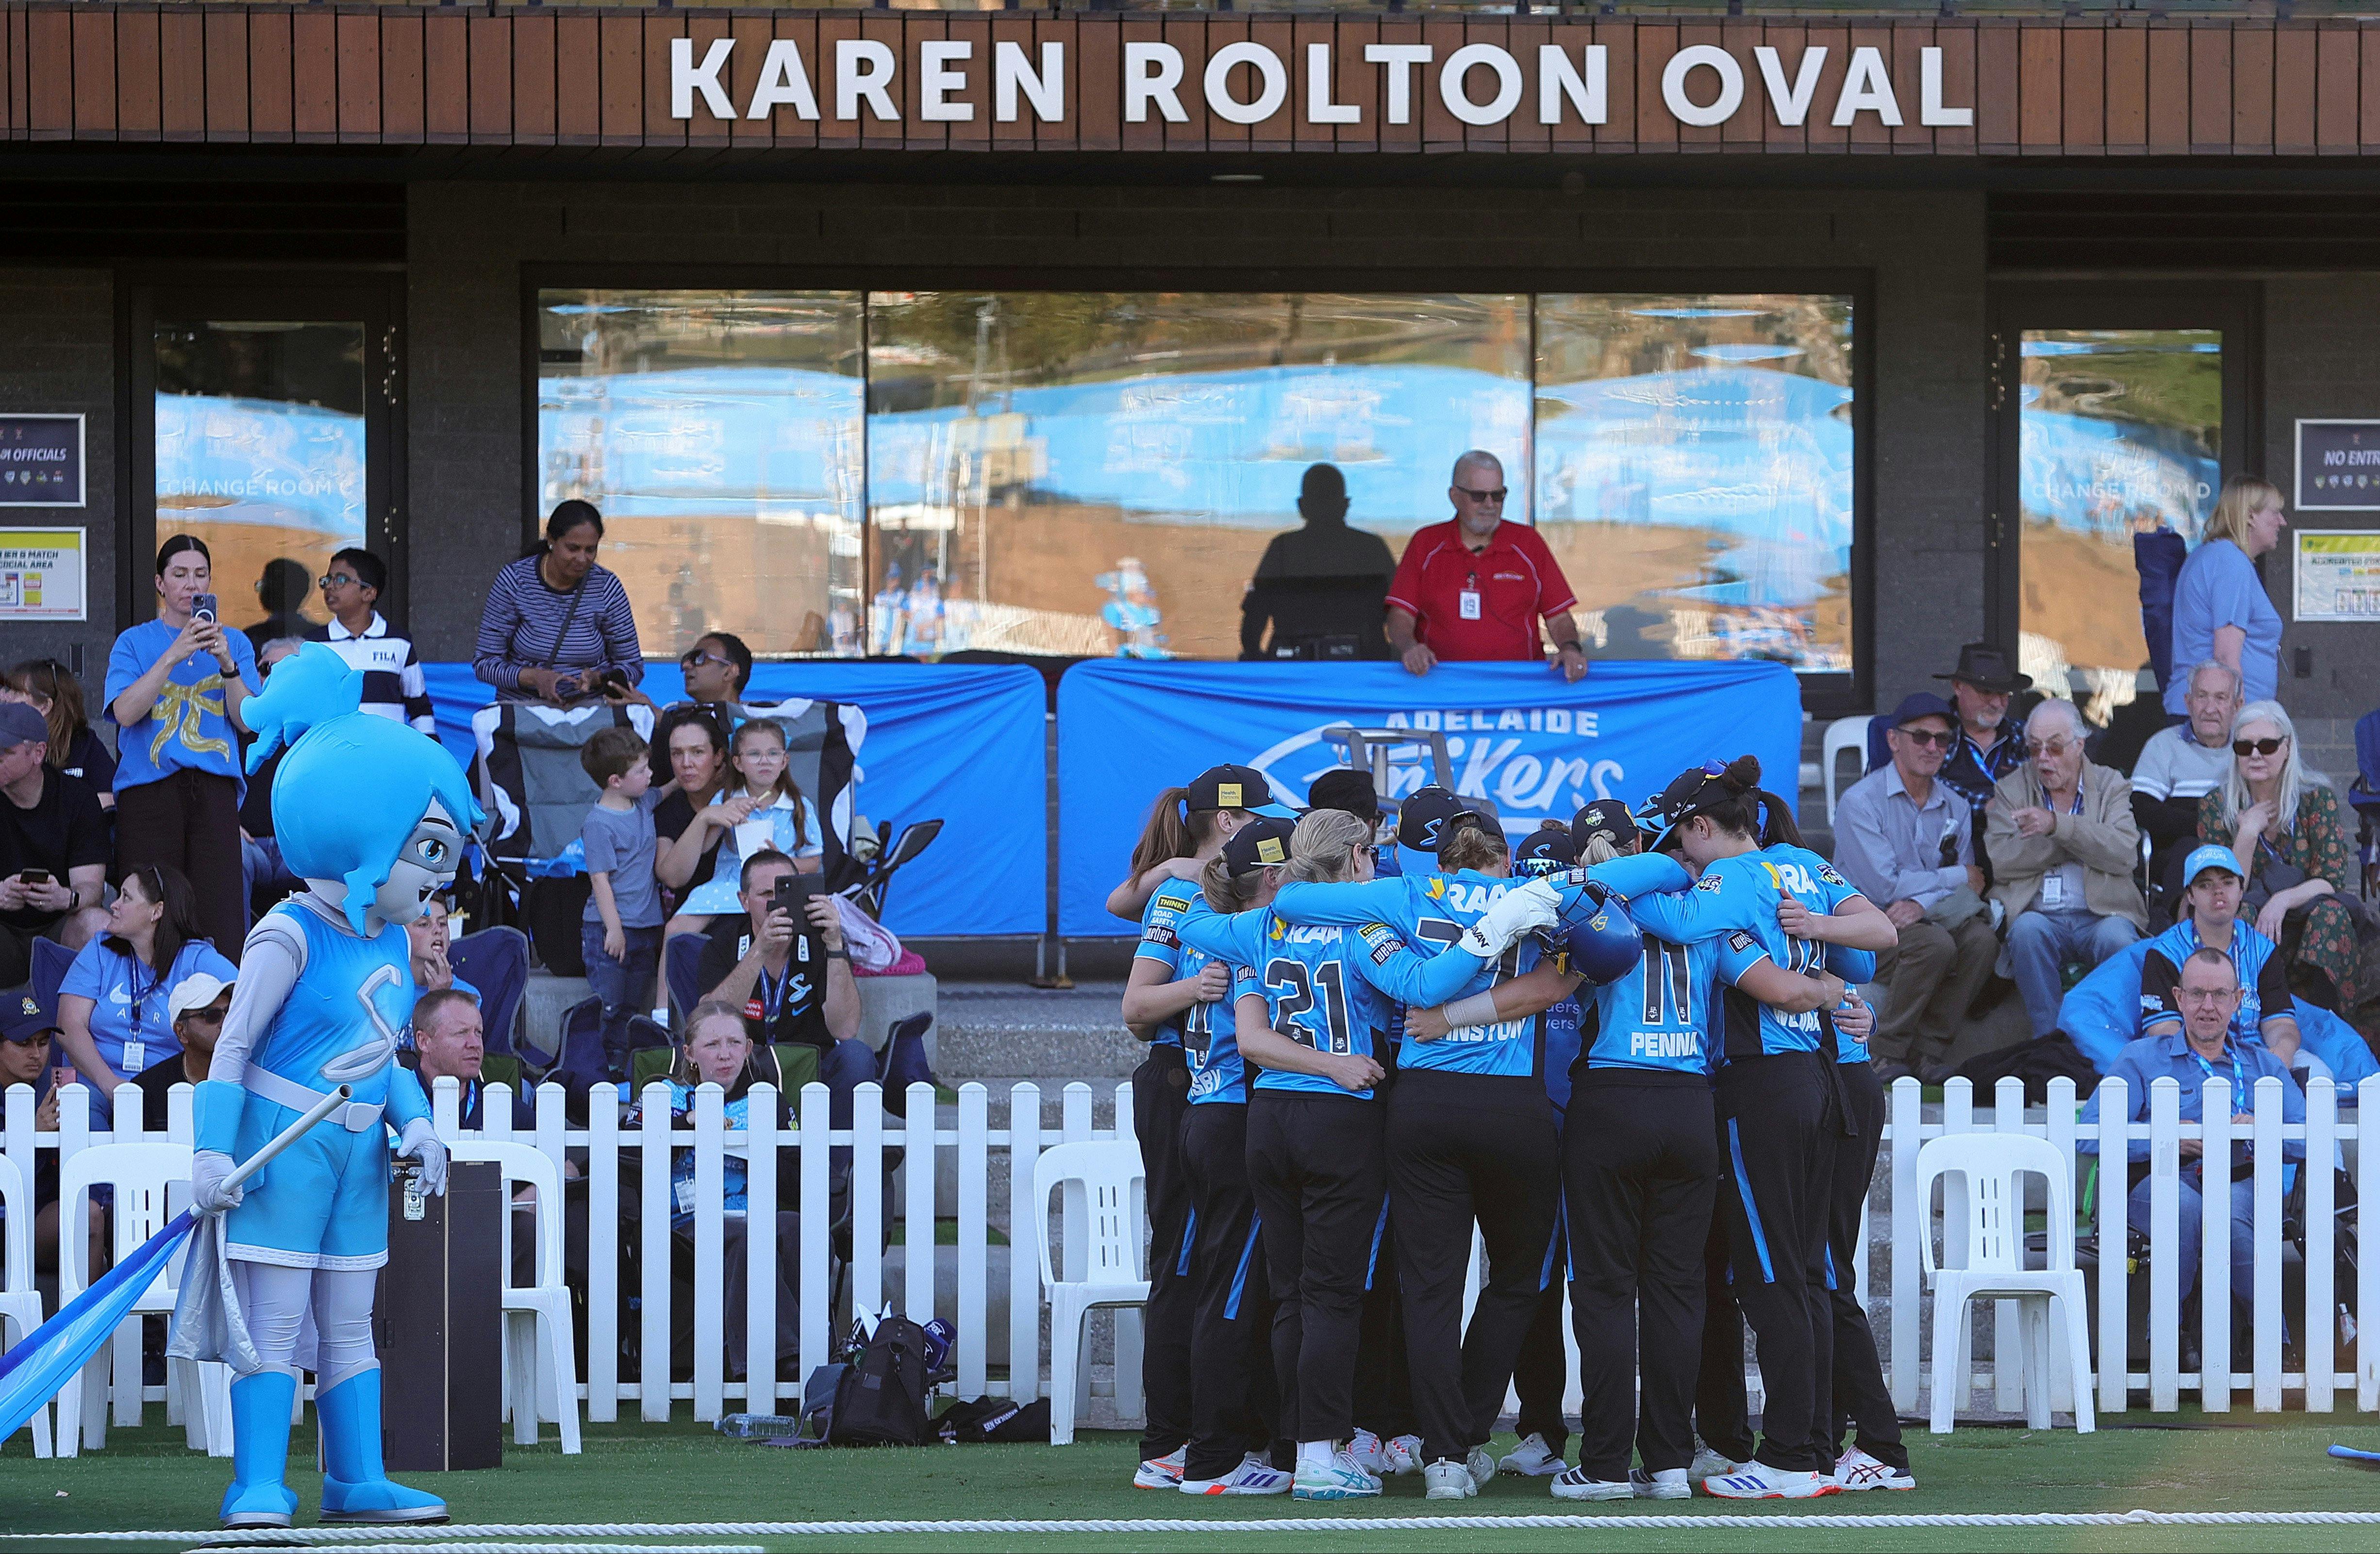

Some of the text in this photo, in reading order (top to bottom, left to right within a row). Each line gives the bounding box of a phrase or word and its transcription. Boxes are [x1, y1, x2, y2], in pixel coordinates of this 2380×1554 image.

[670, 38, 1974, 126] KAREN ROLTON OVAL
[13, 448, 67, 461] OFFICIALS
[2324, 450, 2347, 466] NO
[167, 479, 259, 496] CHANGE
[266, 479, 333, 496] ROOM
[2197, 482, 2211, 499] D
[373, 651, 396, 664] FILA
[1384, 709, 1599, 737] ADELAIDE
[1160, 898, 1186, 910] THINK!
[1151, 917, 1176, 927] SAFETY
[1153, 910, 1173, 918] ROAD
[1365, 929, 1387, 944] ROAD
[1369, 933, 1396, 949] SAFETY
[1265, 957, 1351, 1056] 21
[1631, 1031, 1698, 1057] PENNA
[928, 1321, 943, 1336] FOX
